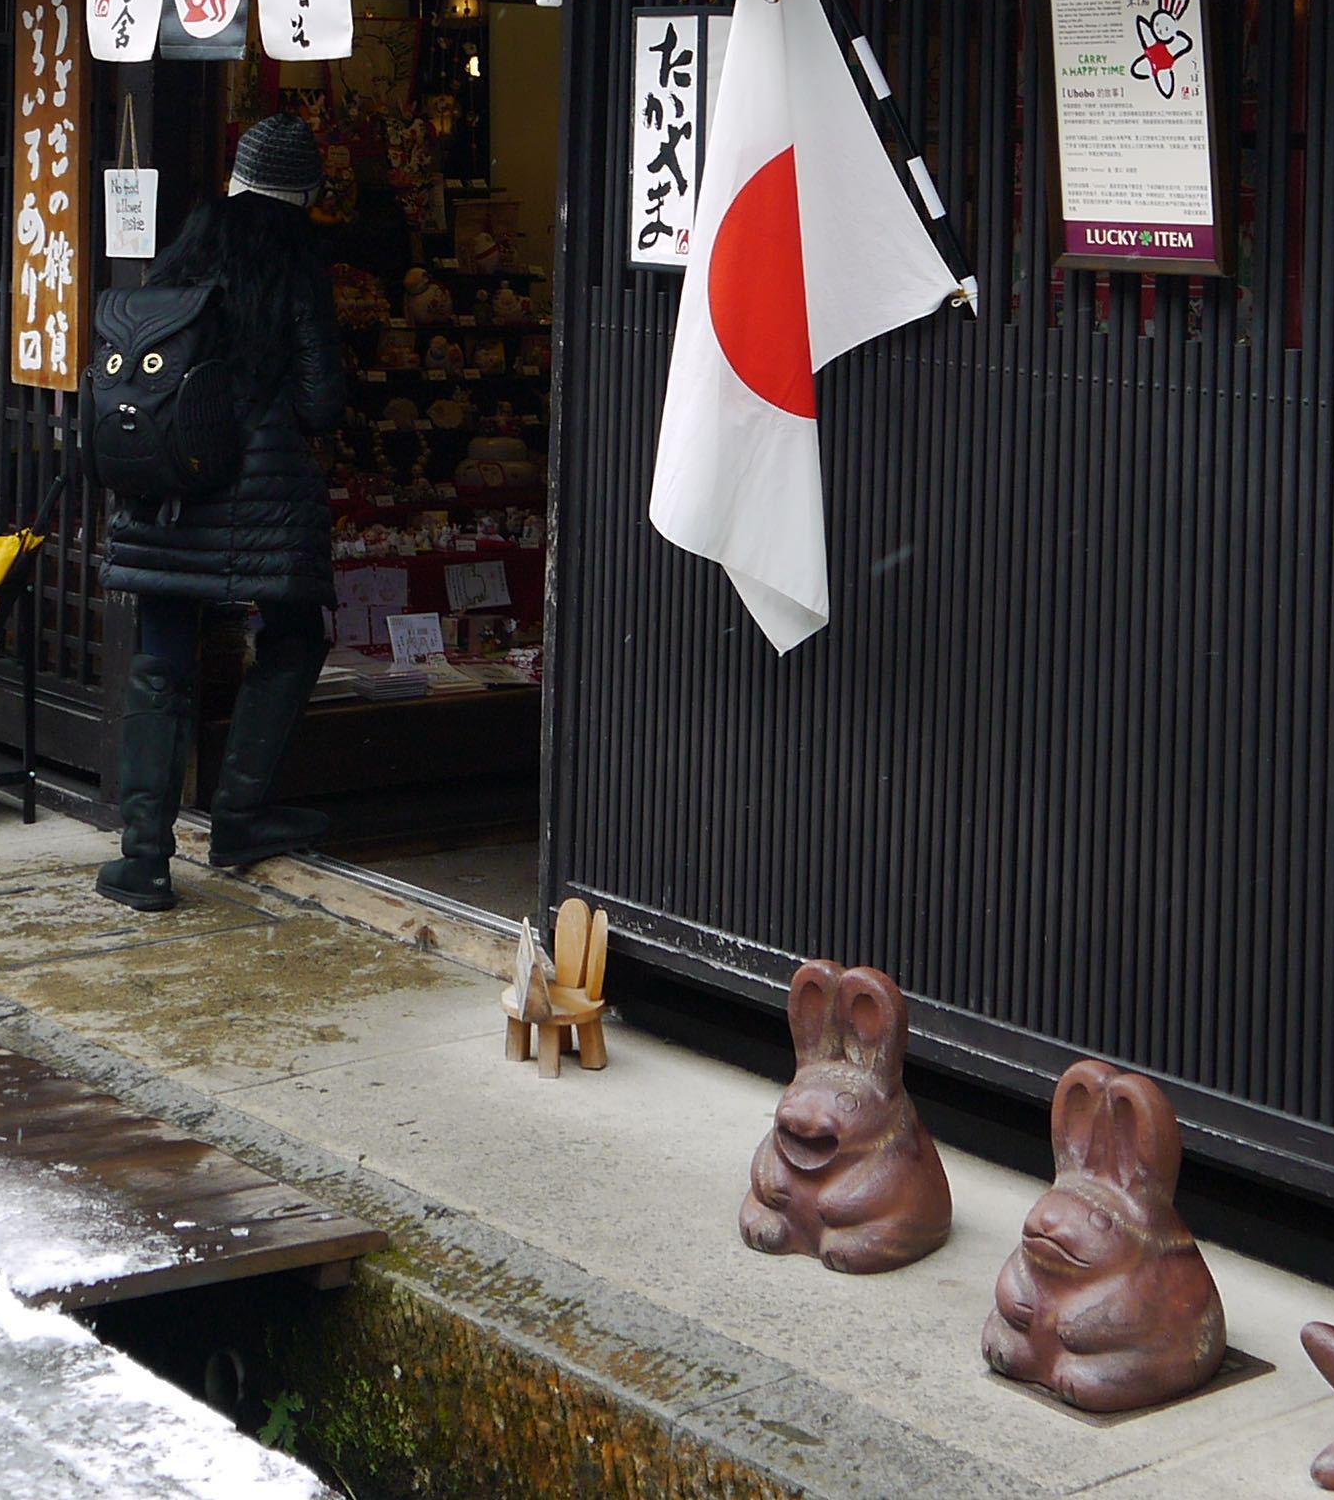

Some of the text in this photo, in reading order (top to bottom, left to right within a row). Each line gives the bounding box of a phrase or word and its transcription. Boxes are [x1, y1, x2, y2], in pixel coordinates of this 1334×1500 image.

[1078, 53, 1108, 65] CARRY
[1069, 67, 1099, 77] HAPPY
[1102, 65, 1126, 76] TIME
[637, 21, 694, 251] たかやま
[1086, 228, 1194, 248] LUCKY ITEM
